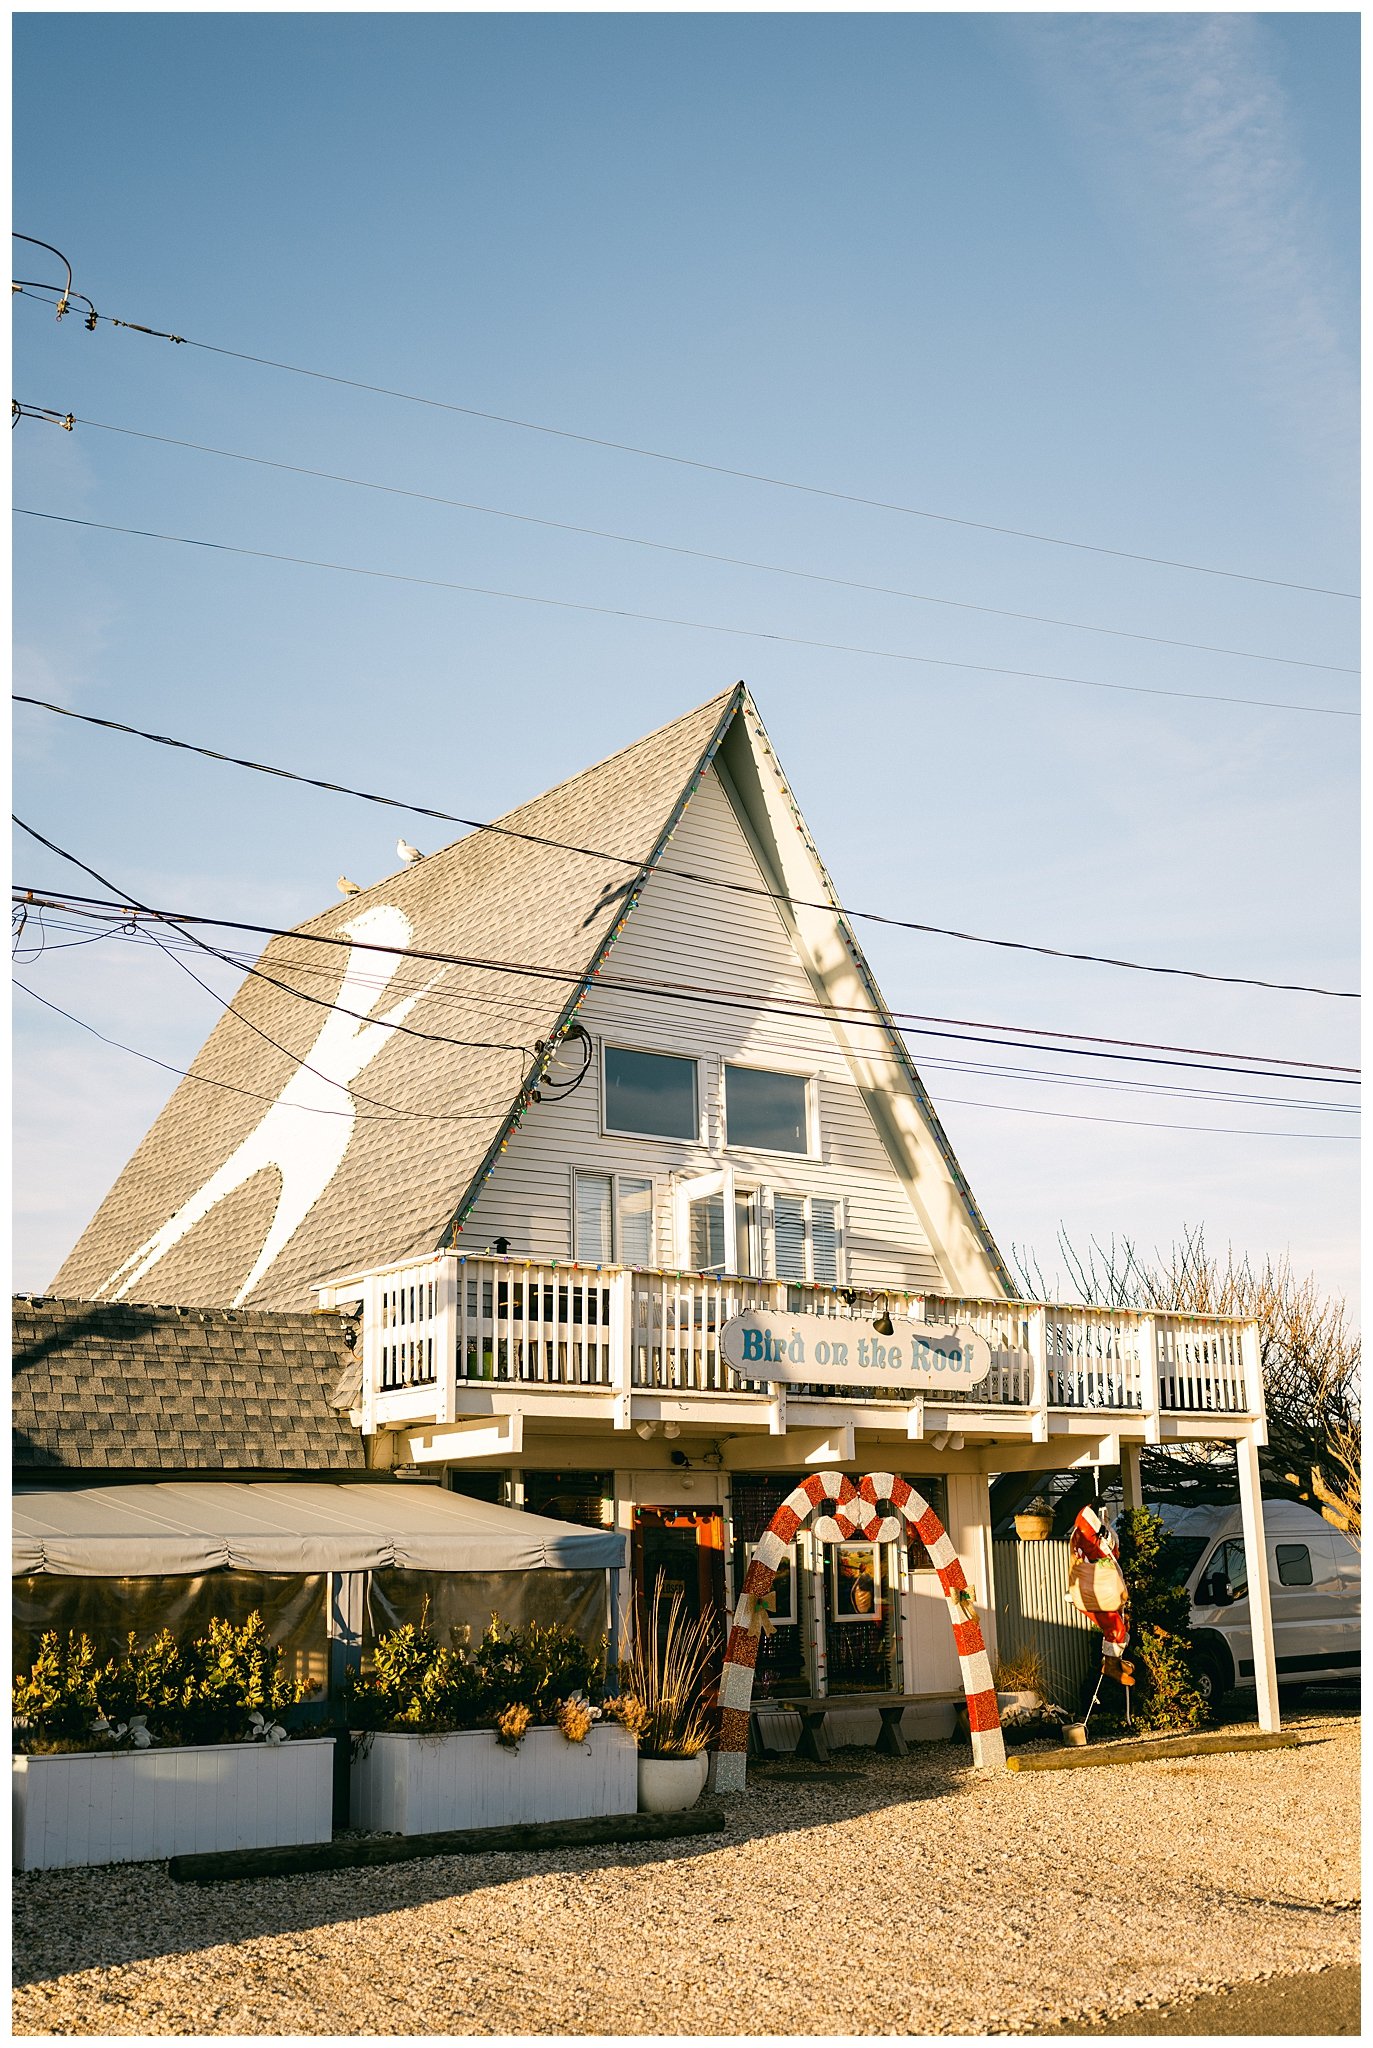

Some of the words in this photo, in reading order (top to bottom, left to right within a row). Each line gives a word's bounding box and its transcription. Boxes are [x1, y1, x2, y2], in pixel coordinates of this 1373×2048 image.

[742, 1328, 805, 1363] Bird
[814, 1340, 849, 1366] on
[857, 1338, 903, 1370] the
[911, 1340, 974, 1373] Roof
[660, 1583, 683, 1593] LOSED
